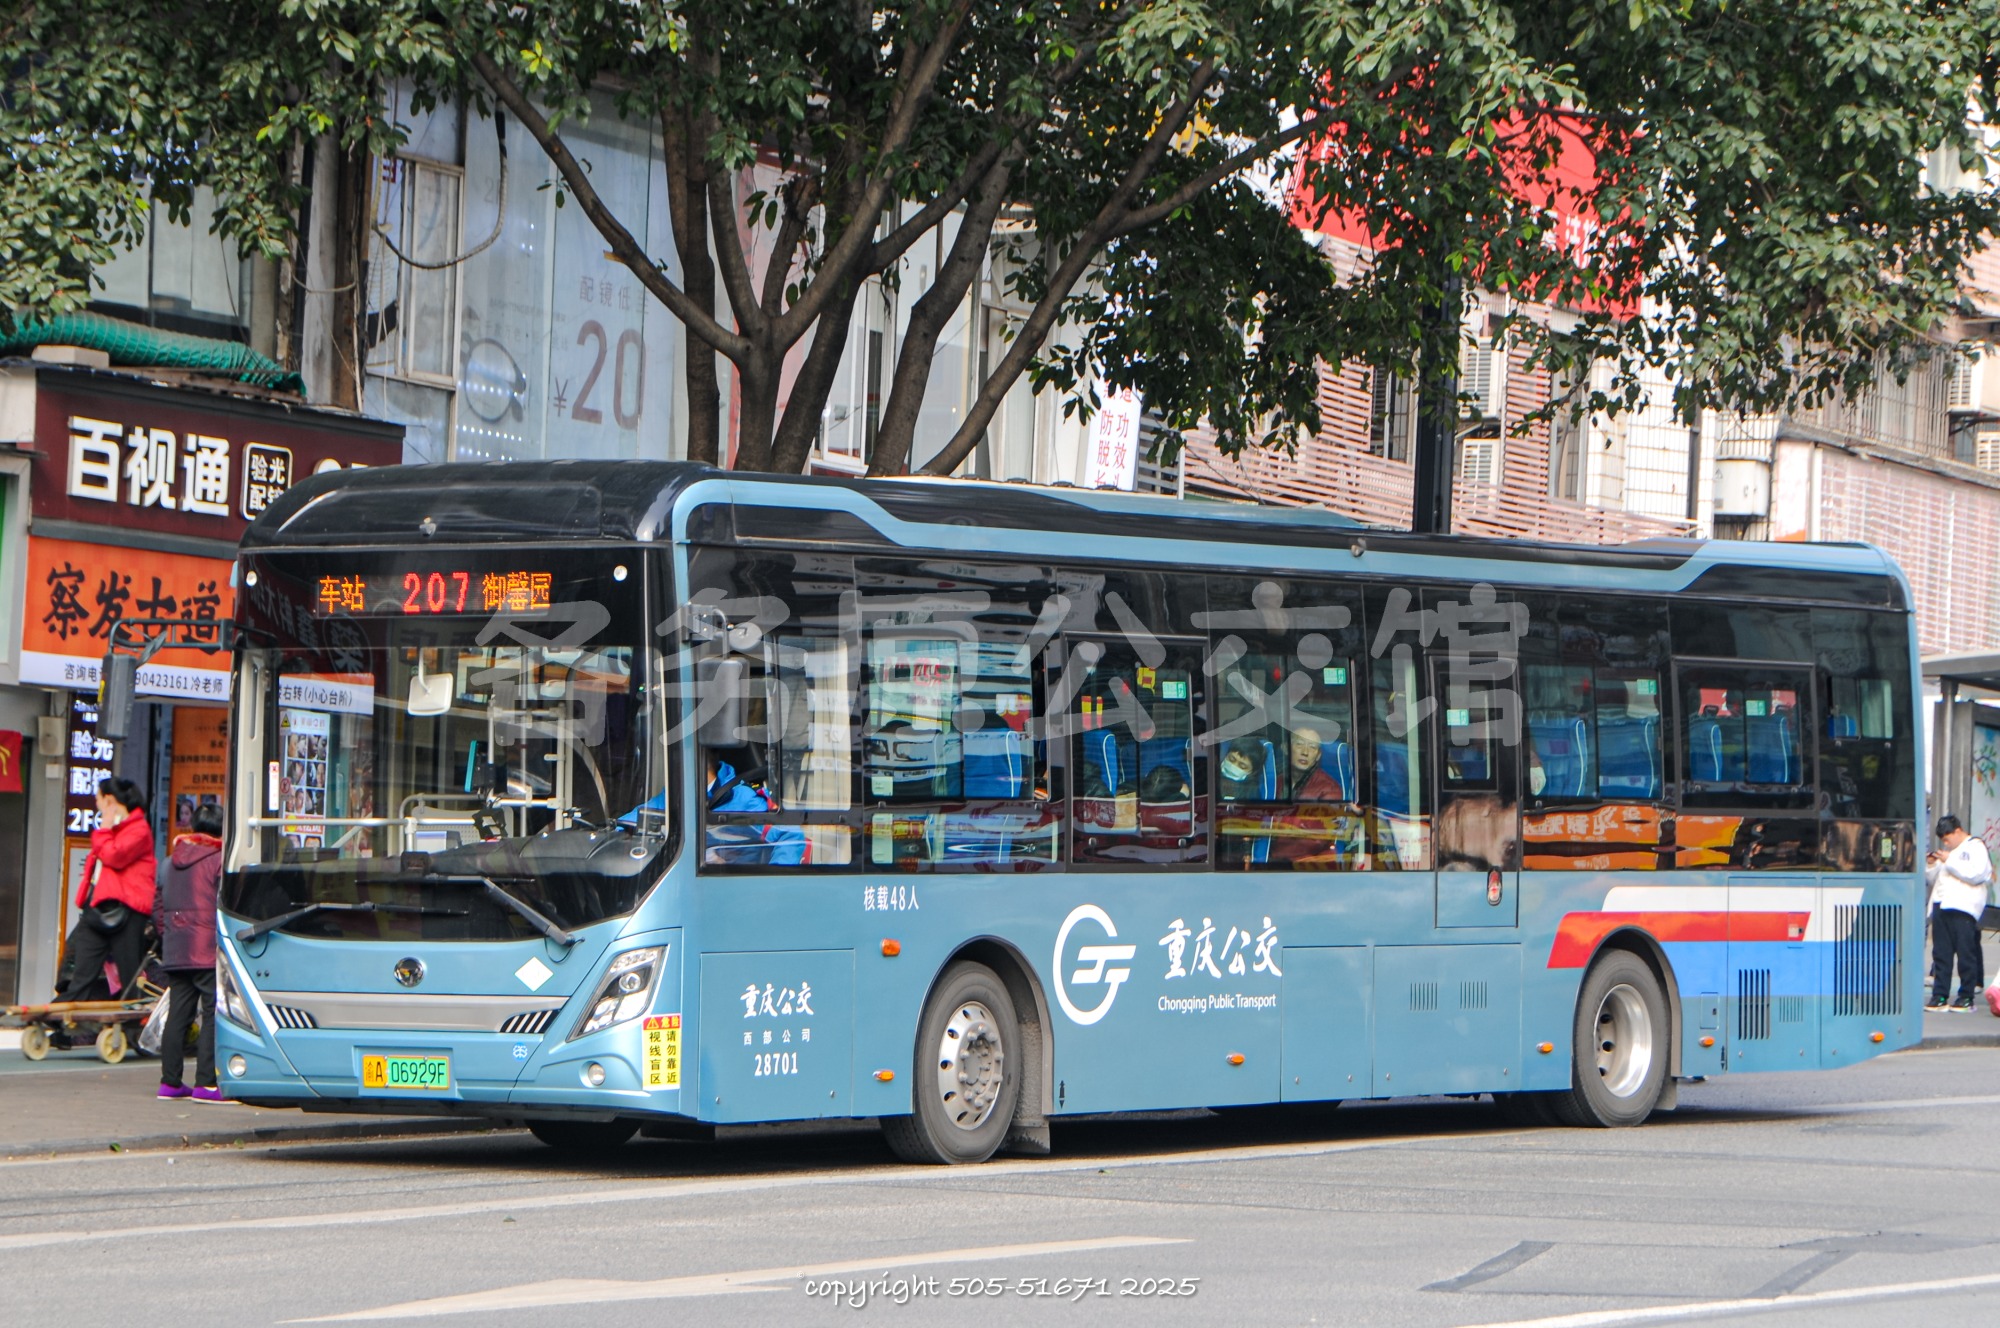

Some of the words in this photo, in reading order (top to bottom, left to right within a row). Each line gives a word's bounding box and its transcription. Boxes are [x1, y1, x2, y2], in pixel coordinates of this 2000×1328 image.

[68, 416, 230, 517] 百视通
[251, 454, 286, 485] 验光
[43, 561, 221, 656] 察发古道
[319, 574, 366, 614] 车站
[402, 572, 470, 613] 207
[65, 663, 102, 683] 咨询电
[190, 676, 223, 695] 冷老师
[71, 730, 113, 761] 验光
[863, 885, 919, 911] 核载48人
[1158, 916, 1282, 980] 重庆公交
[740, 981, 814, 1018] 重庆公交
[1158, 996, 1207, 1013] Chongqing
[1208, 993, 1235, 1009] Public
[1236, 993, 1277, 1011] Transport
[743, 1028, 811, 1046] 西部公司
[391, 1061, 446, 1084] 06929F
[649, 1031, 661, 1084] 视线盲区
[666, 1030, 677, 1083] 请勿靠近
[754, 1052, 799, 1077] 28701
